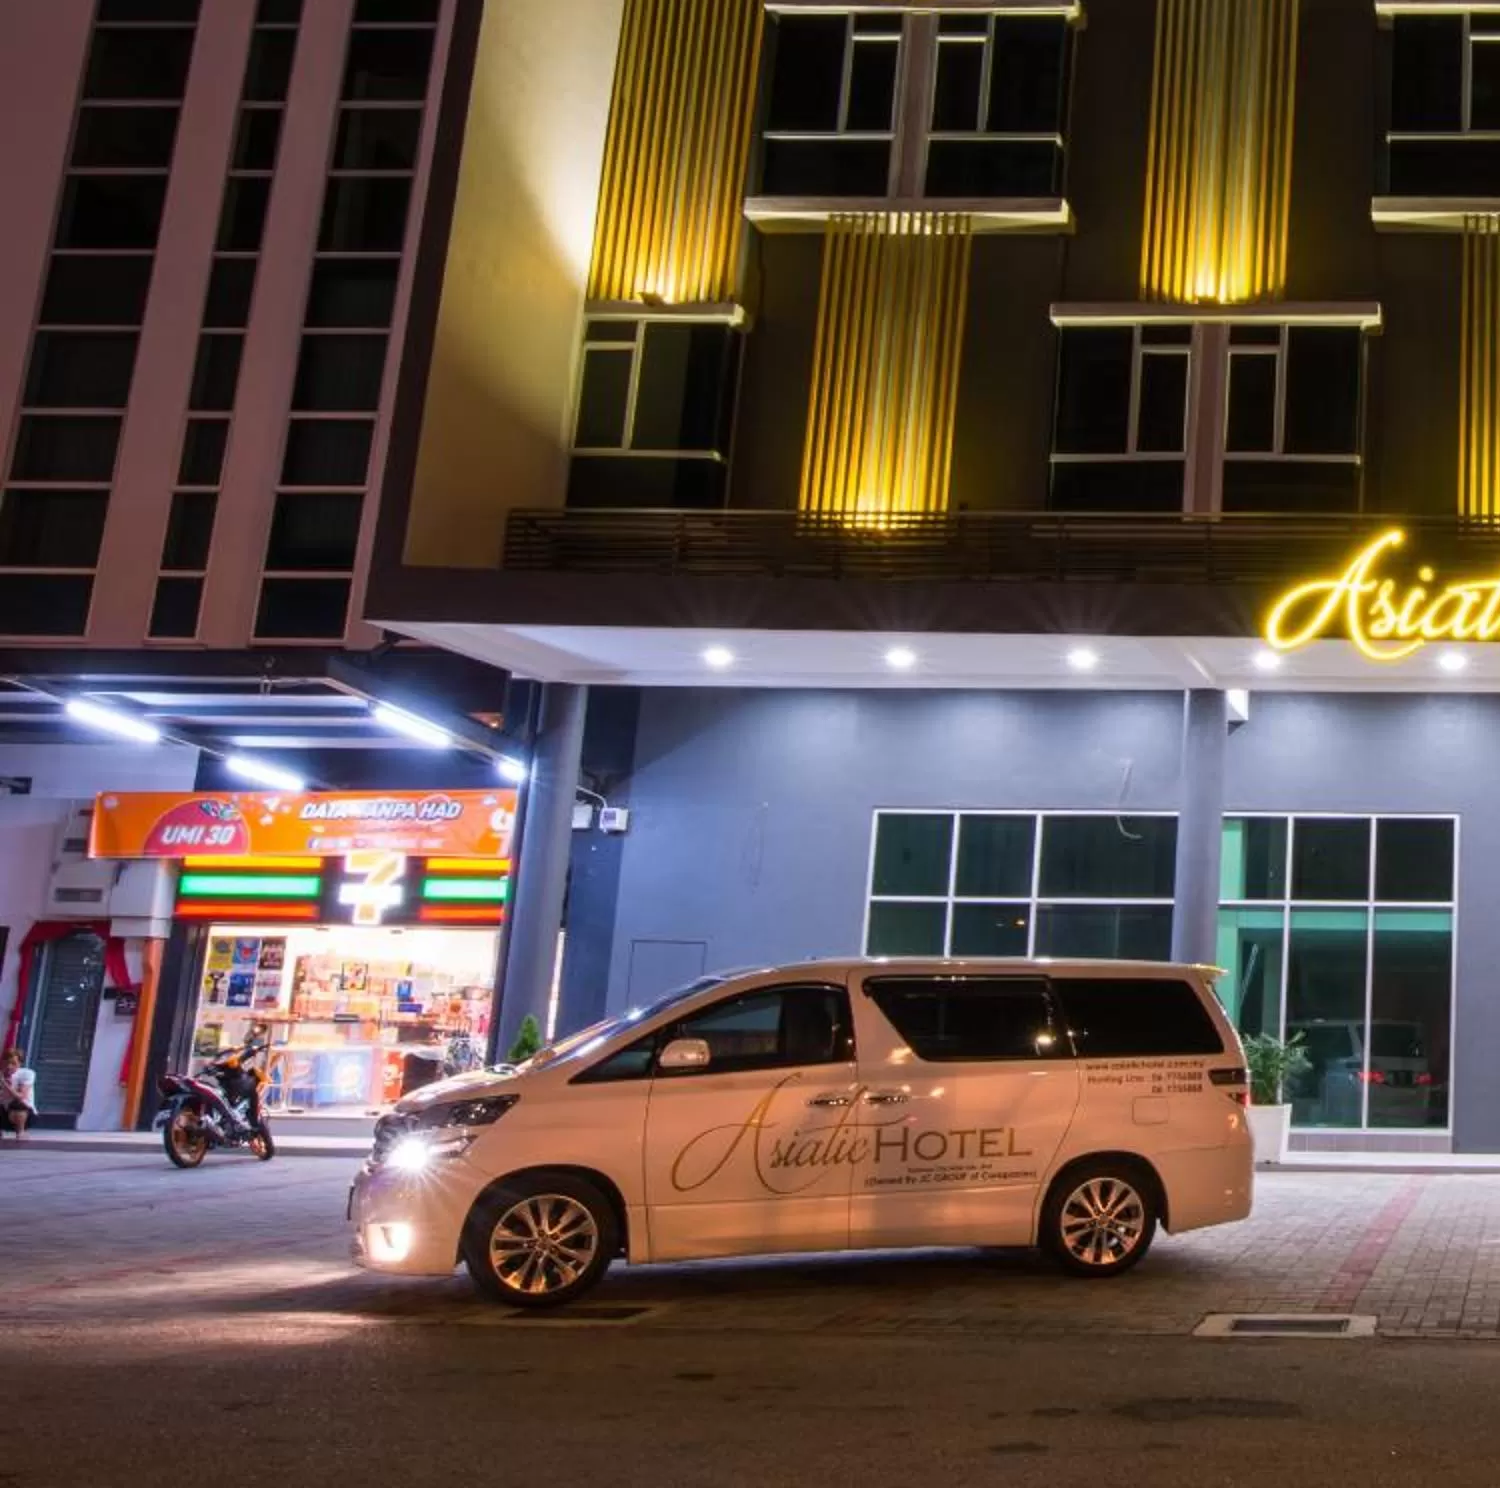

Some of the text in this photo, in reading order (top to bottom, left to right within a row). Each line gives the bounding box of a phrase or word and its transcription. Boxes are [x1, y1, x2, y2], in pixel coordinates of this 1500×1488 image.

[417, 800, 463, 820] HAD
[161, 825, 237, 845] UMI 30
[671, 1072, 1033, 1194] Asiatic HOTEL
